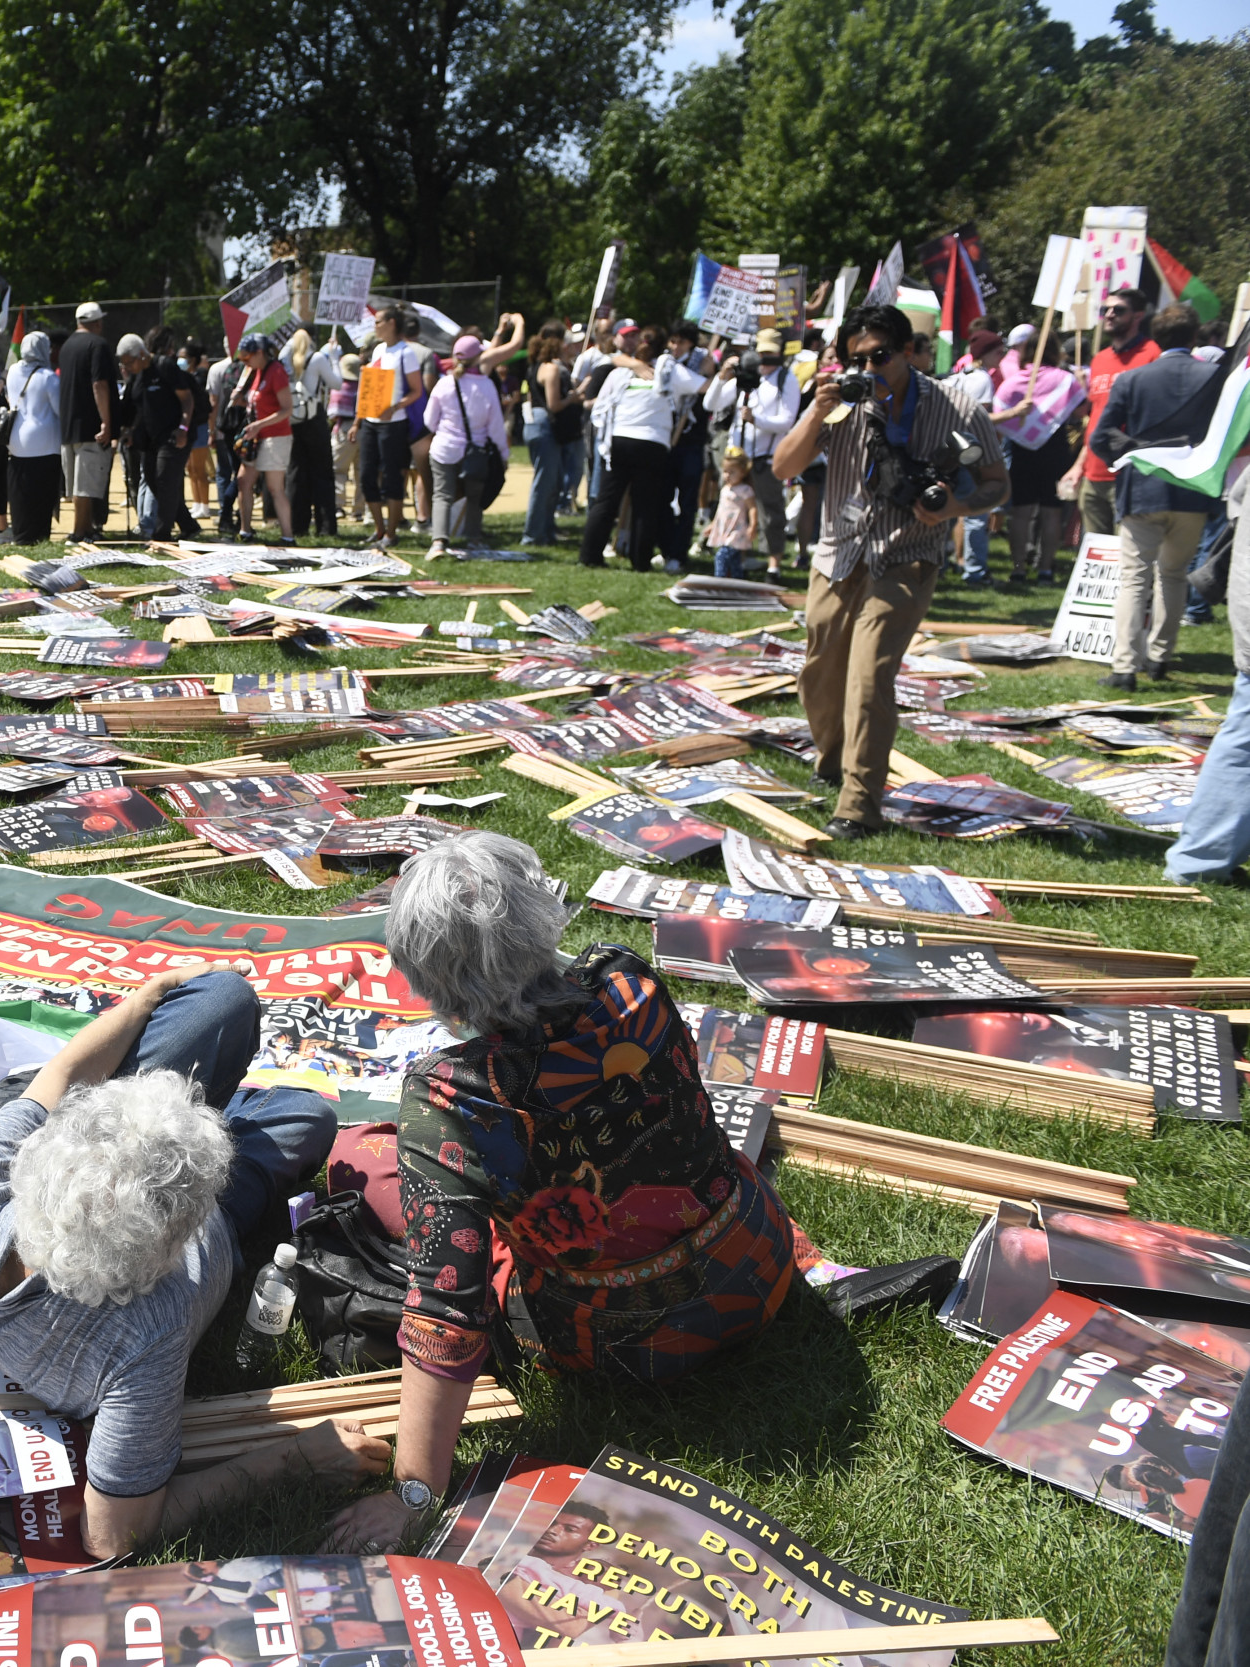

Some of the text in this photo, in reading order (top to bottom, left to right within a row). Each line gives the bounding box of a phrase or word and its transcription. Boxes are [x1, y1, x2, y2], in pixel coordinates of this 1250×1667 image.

[16, 815, 42, 835] THE
[20, 805, 58, 839] CRATS
[20, 832, 40, 847] OF
[44, 892, 290, 946] UNAC
[718, 894, 748, 921] OF
[872, 884, 907, 907] OF
[283, 971, 400, 1006] The
[799, 1035, 815, 1056] NOT
[1129, 1009, 1149, 1083] EMOCRATS
[1152, 1020, 1174, 1089] FUND THE
[1176, 1012, 1199, 1108] GENOCIDE OF
[1199, 1014, 1217, 1114] PALESTINIANS
[968, 1364, 1016, 1413] FREE
[1046, 1351, 1120, 1413] END
[1088, 1397, 1155, 1457] U.S.
[1173, 1397, 1231, 1434] TO
[34, 1450, 58, 1484] END
[605, 1455, 947, 1626] STAND WITH PALESTINE
[400, 1574, 434, 1617] JOBS,
[588, 1522, 782, 1636] DEMOCRA
[697, 1529, 811, 1619] BOTH
[521, 1578, 641, 1639] HAVE
